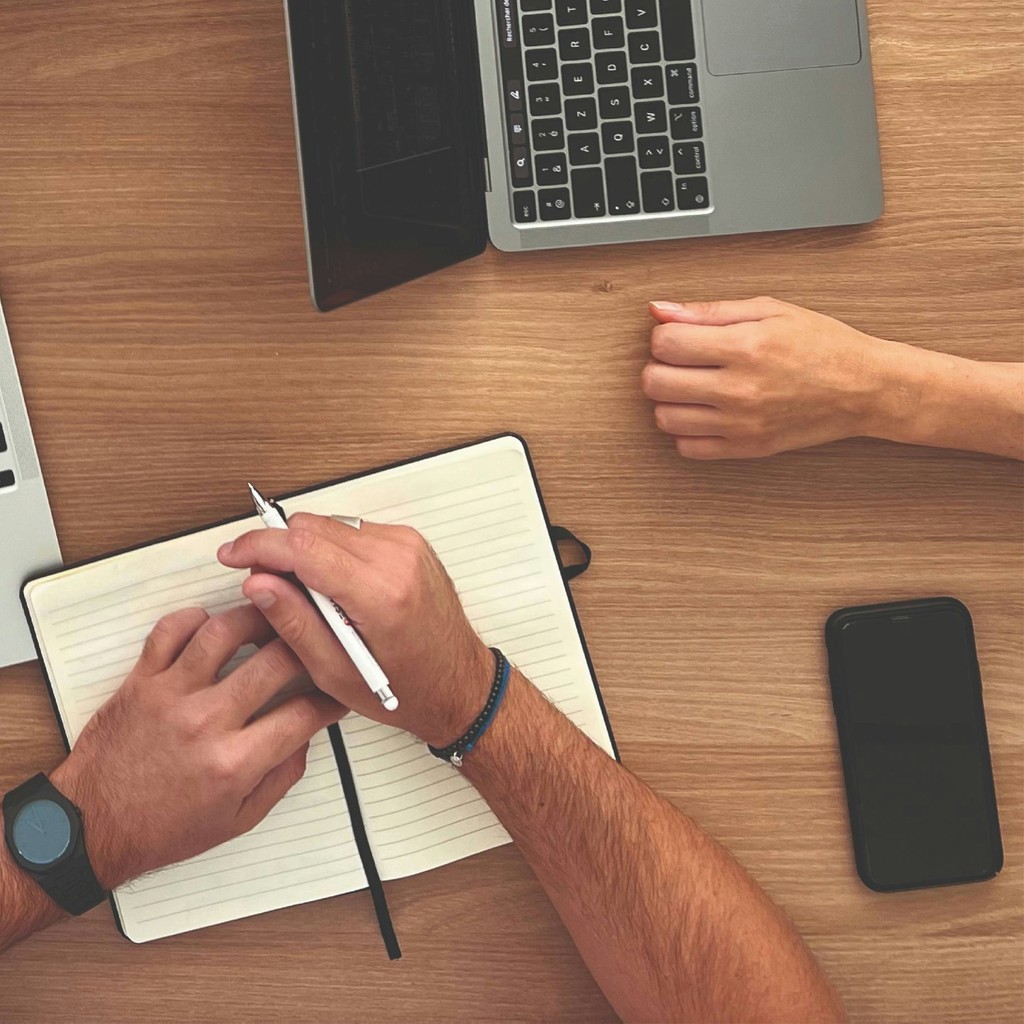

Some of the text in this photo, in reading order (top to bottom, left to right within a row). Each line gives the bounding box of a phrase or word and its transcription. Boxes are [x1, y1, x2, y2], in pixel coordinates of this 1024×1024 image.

[504, 7, 513, 42] Rechercher
[686, 67, 695, 99] command
[646, 112, 656, 122] W
[690, 111, 698, 132] option
[613, 133, 623, 141] Q
[692, 146, 701, 169] control
